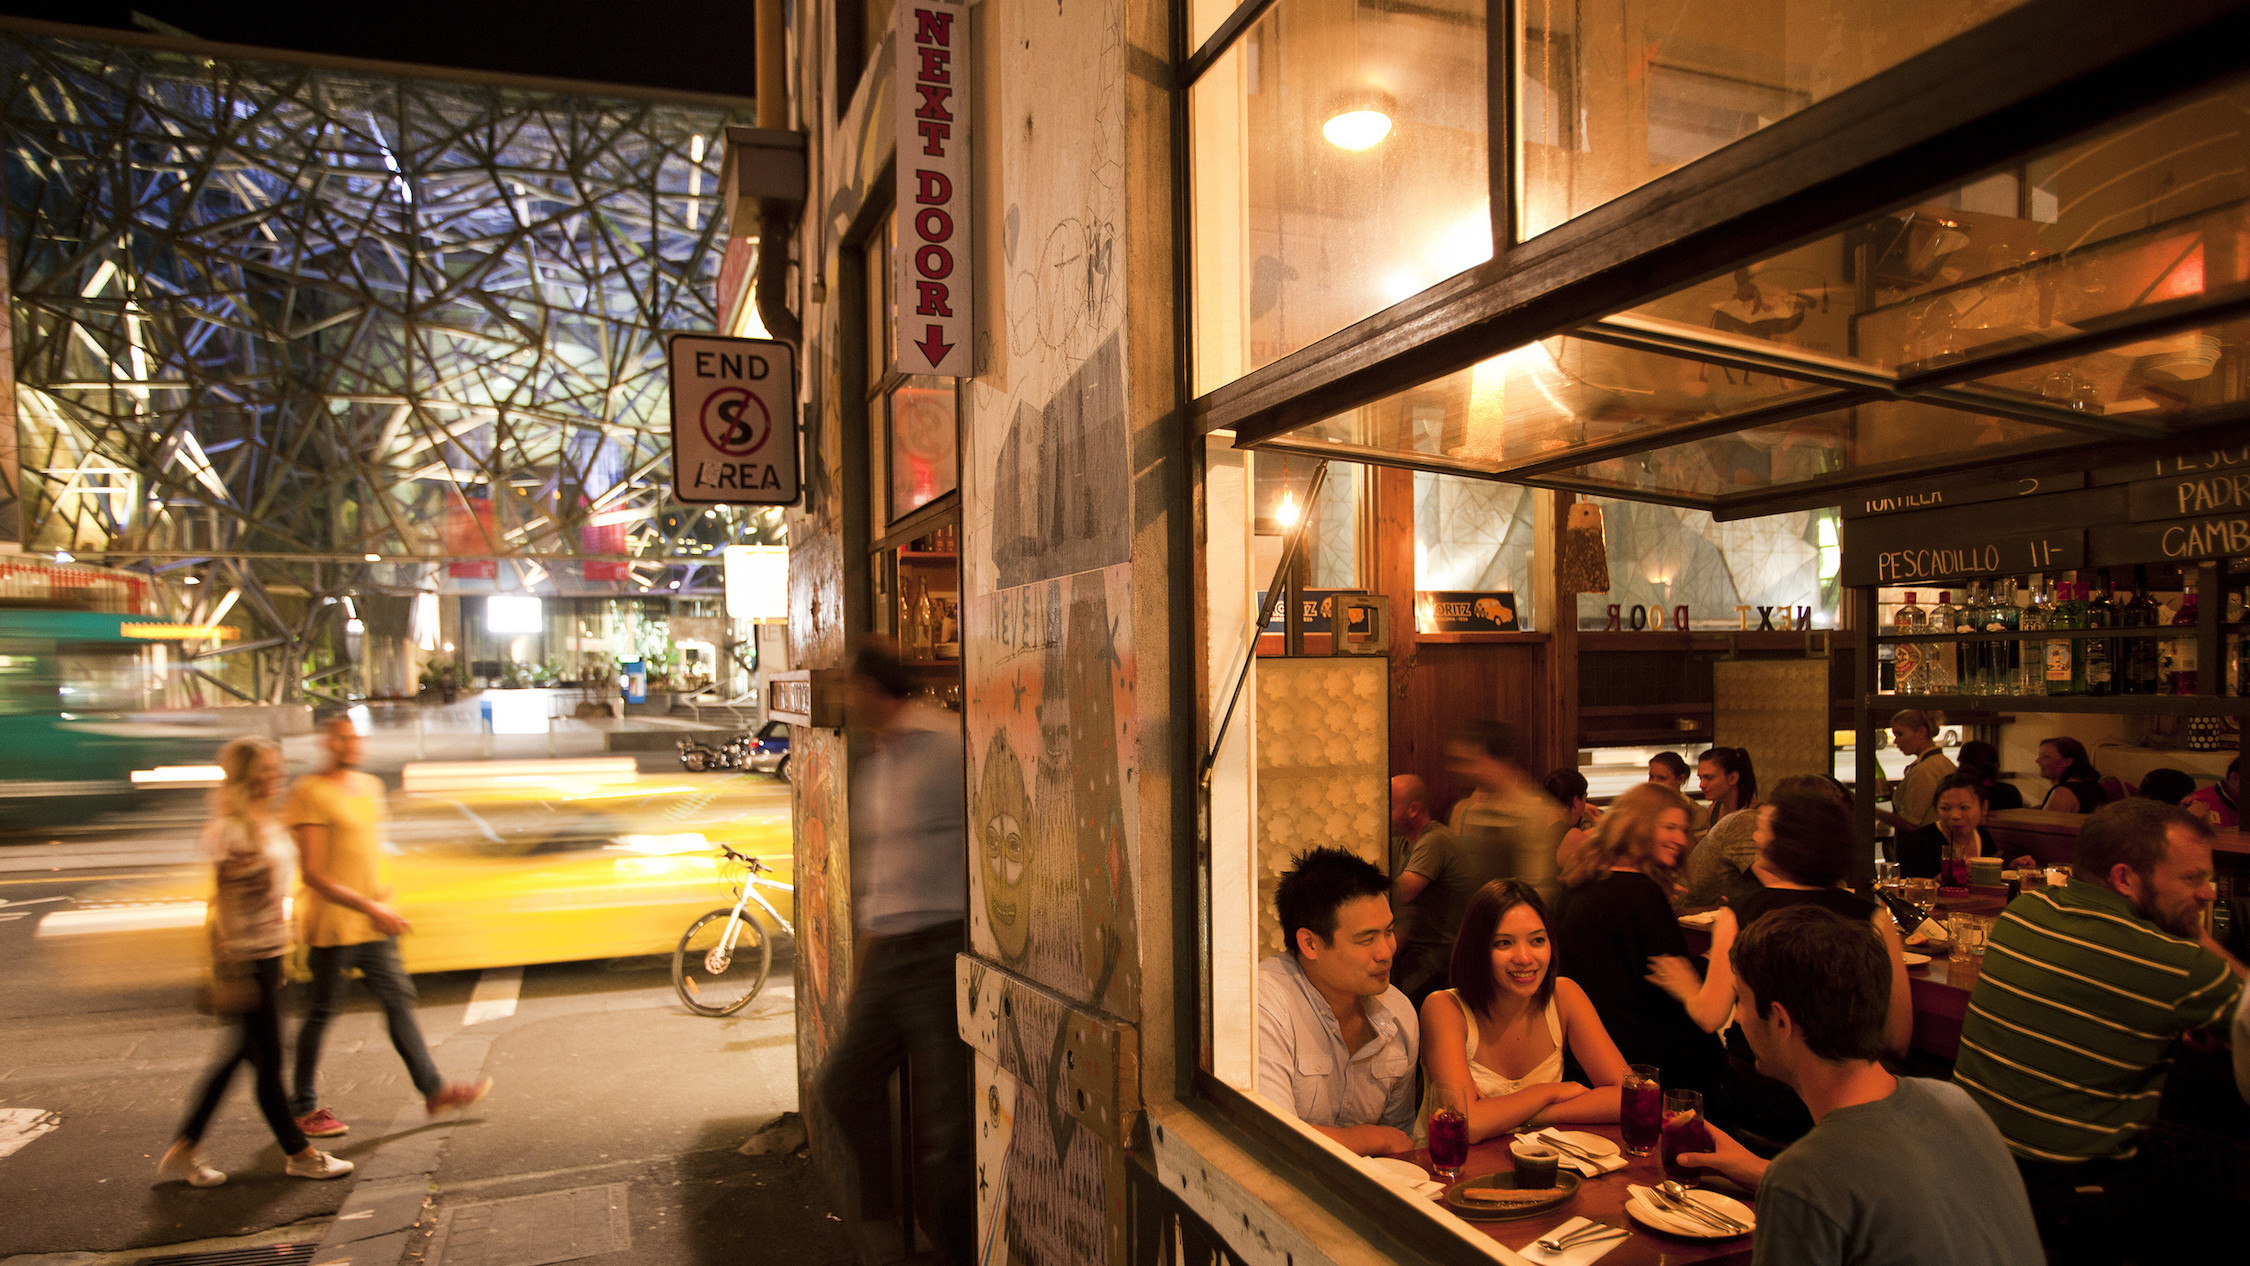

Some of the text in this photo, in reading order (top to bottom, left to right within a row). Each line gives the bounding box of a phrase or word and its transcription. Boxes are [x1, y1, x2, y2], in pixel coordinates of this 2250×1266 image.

[915, 9, 954, 317] NEXT DOOR
[696, 351, 770, 381] END
[1878, 544, 1999, 581] PESCADILLO
